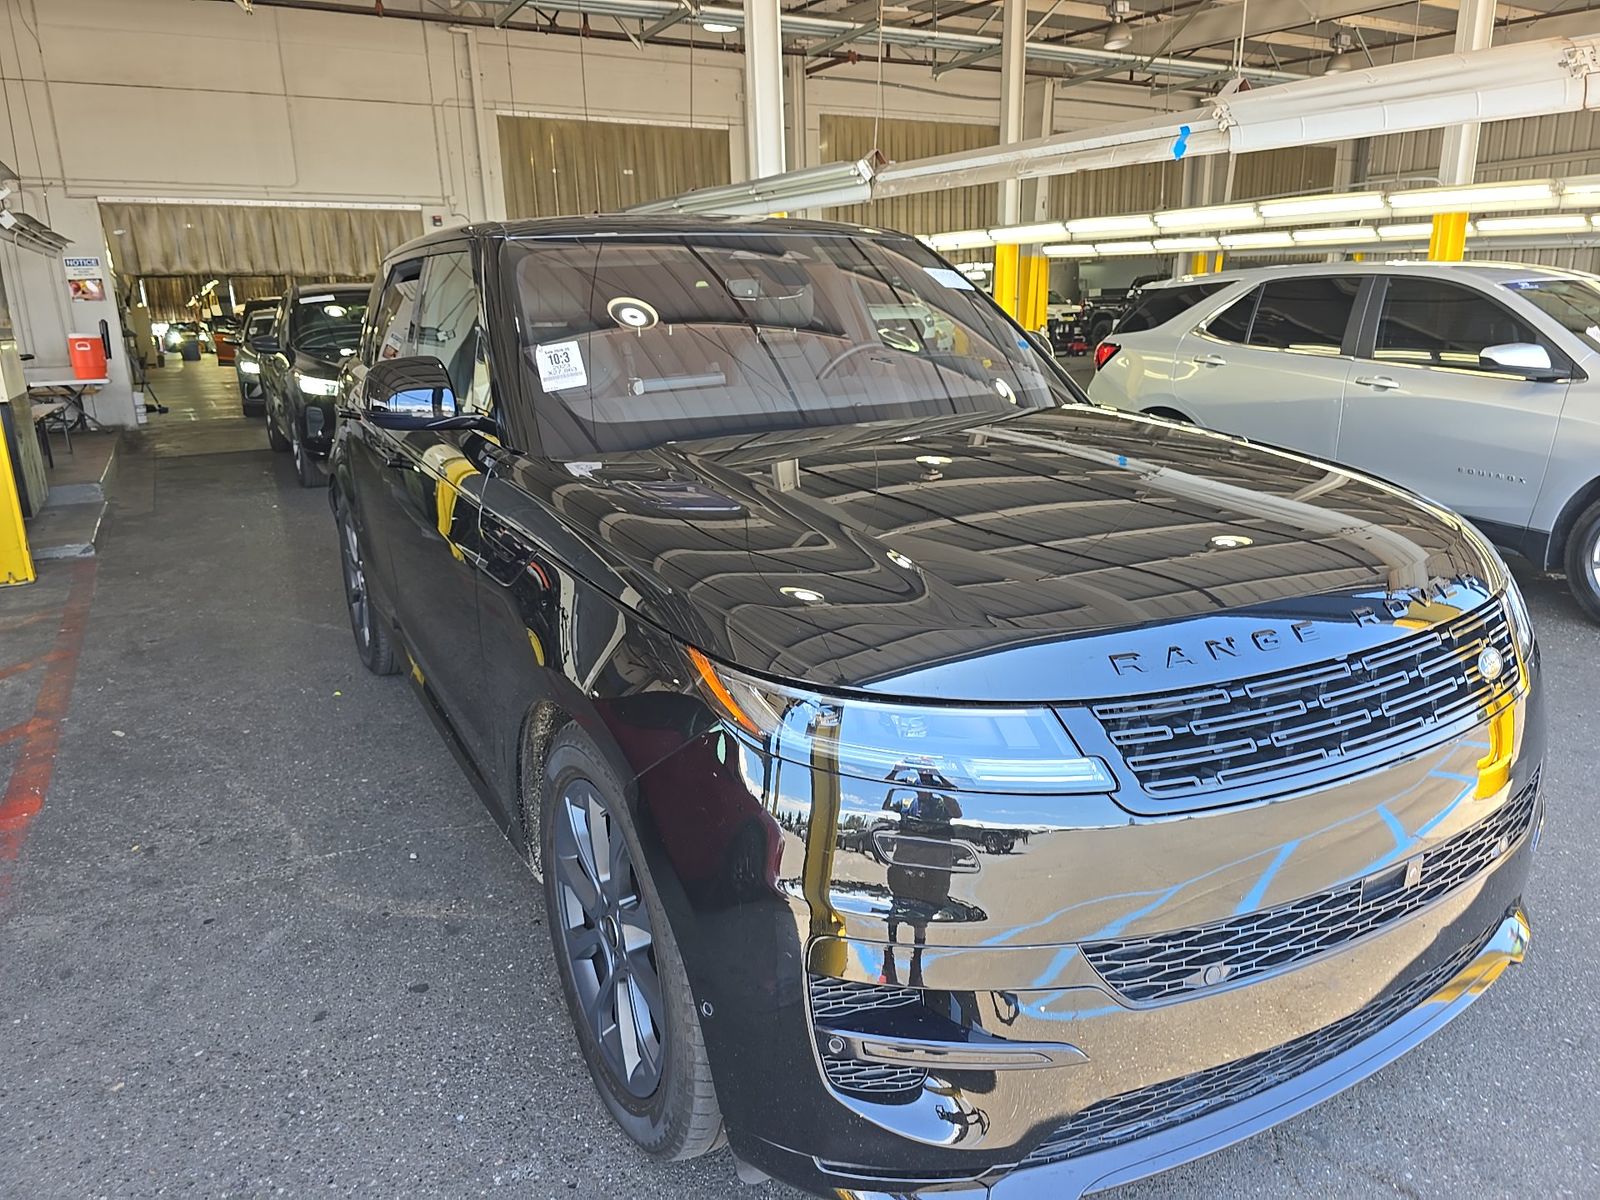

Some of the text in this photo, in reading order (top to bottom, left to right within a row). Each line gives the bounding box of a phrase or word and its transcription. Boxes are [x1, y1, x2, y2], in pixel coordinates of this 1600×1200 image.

[547, 351, 570, 365] 10:3
[1457, 466, 1526, 484] EQUINOX
[1108, 573, 1487, 676] RANGE ROVER
